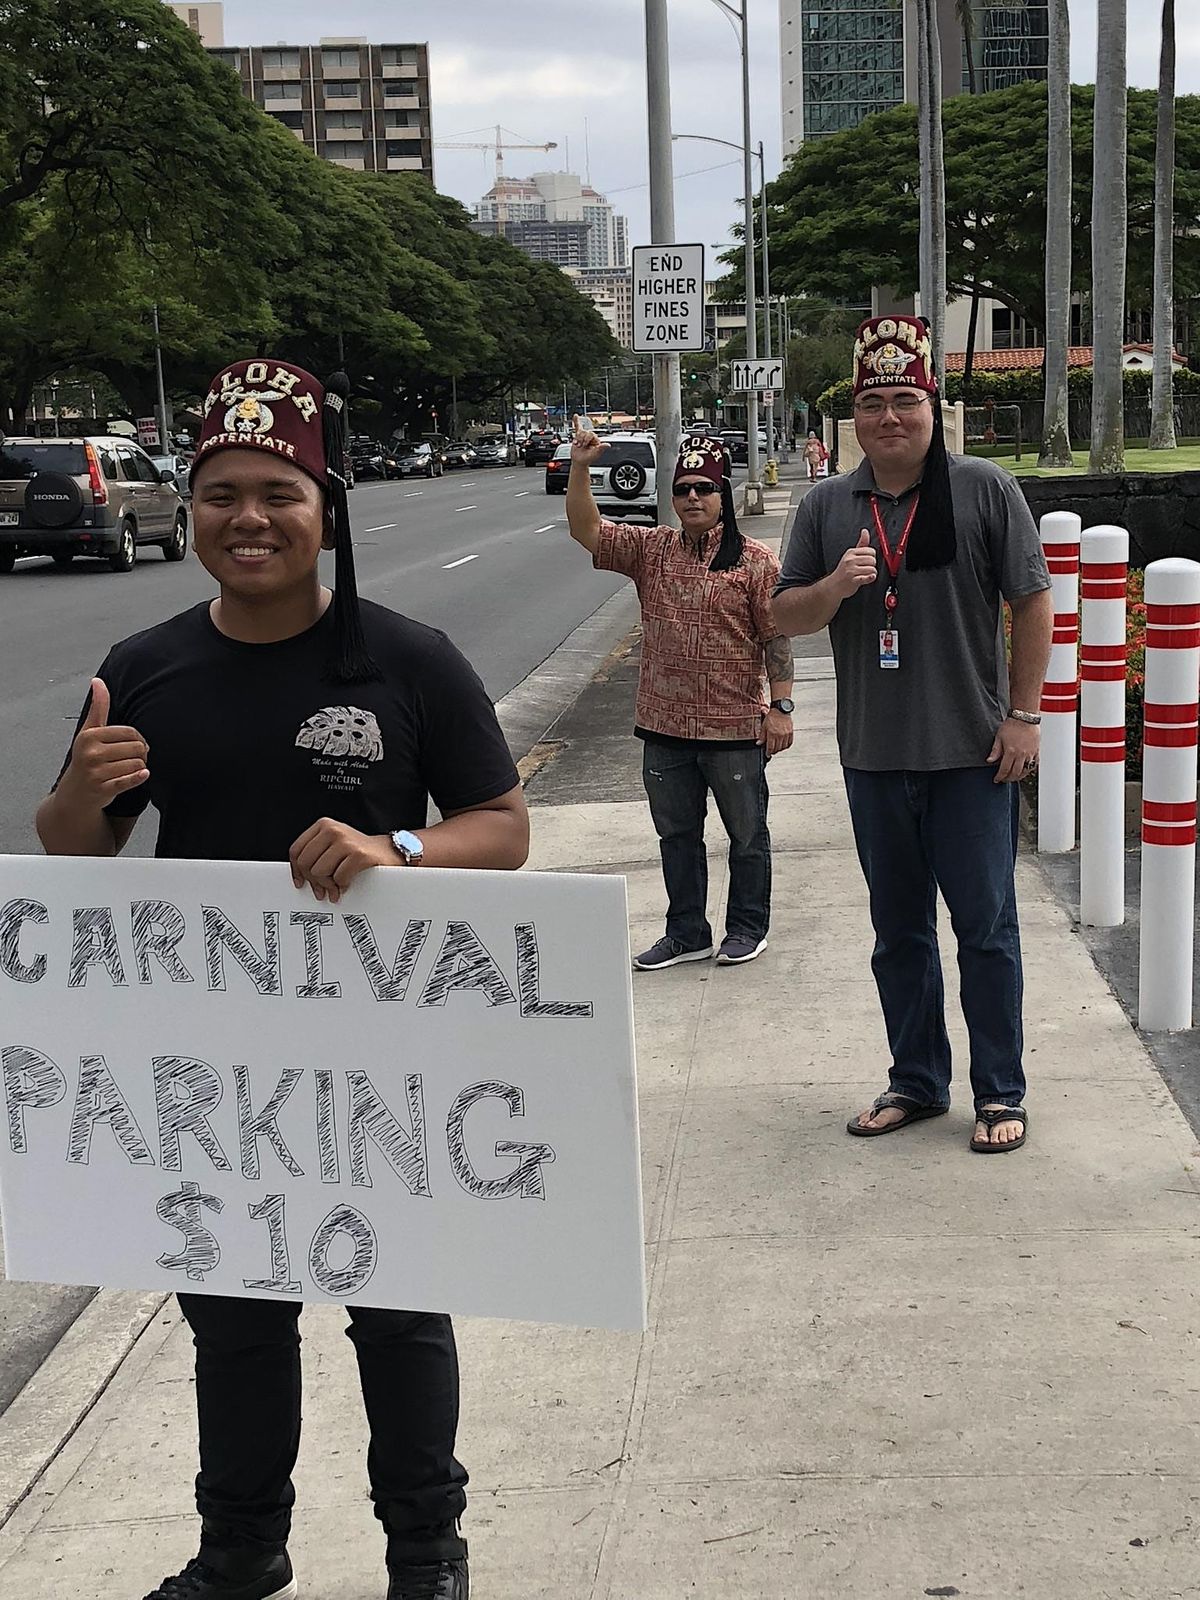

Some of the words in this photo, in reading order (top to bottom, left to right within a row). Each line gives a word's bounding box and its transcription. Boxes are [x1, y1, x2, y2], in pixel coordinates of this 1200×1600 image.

[650, 256, 683, 272] END
[638, 278, 697, 296] HIGHER
[644, 301, 690, 318] FINES
[645, 324, 689, 341] ZONE
[863, 375, 917, 387] POTENTATE
[204, 362, 319, 423] ALOHA
[201, 432, 296, 458] POTENTATE
[312, 757, 332, 766] Made
[349, 761, 369, 769] Aloha
[336, 767, 345, 775] by
[320, 774, 363, 786] RIPCURL
[327, 784, 355, 792] HAWAII
[0, 898, 594, 1019] CARNIVAL
[0, 1045, 557, 1201] PARKING
[155, 1181, 379, 1297] $10
